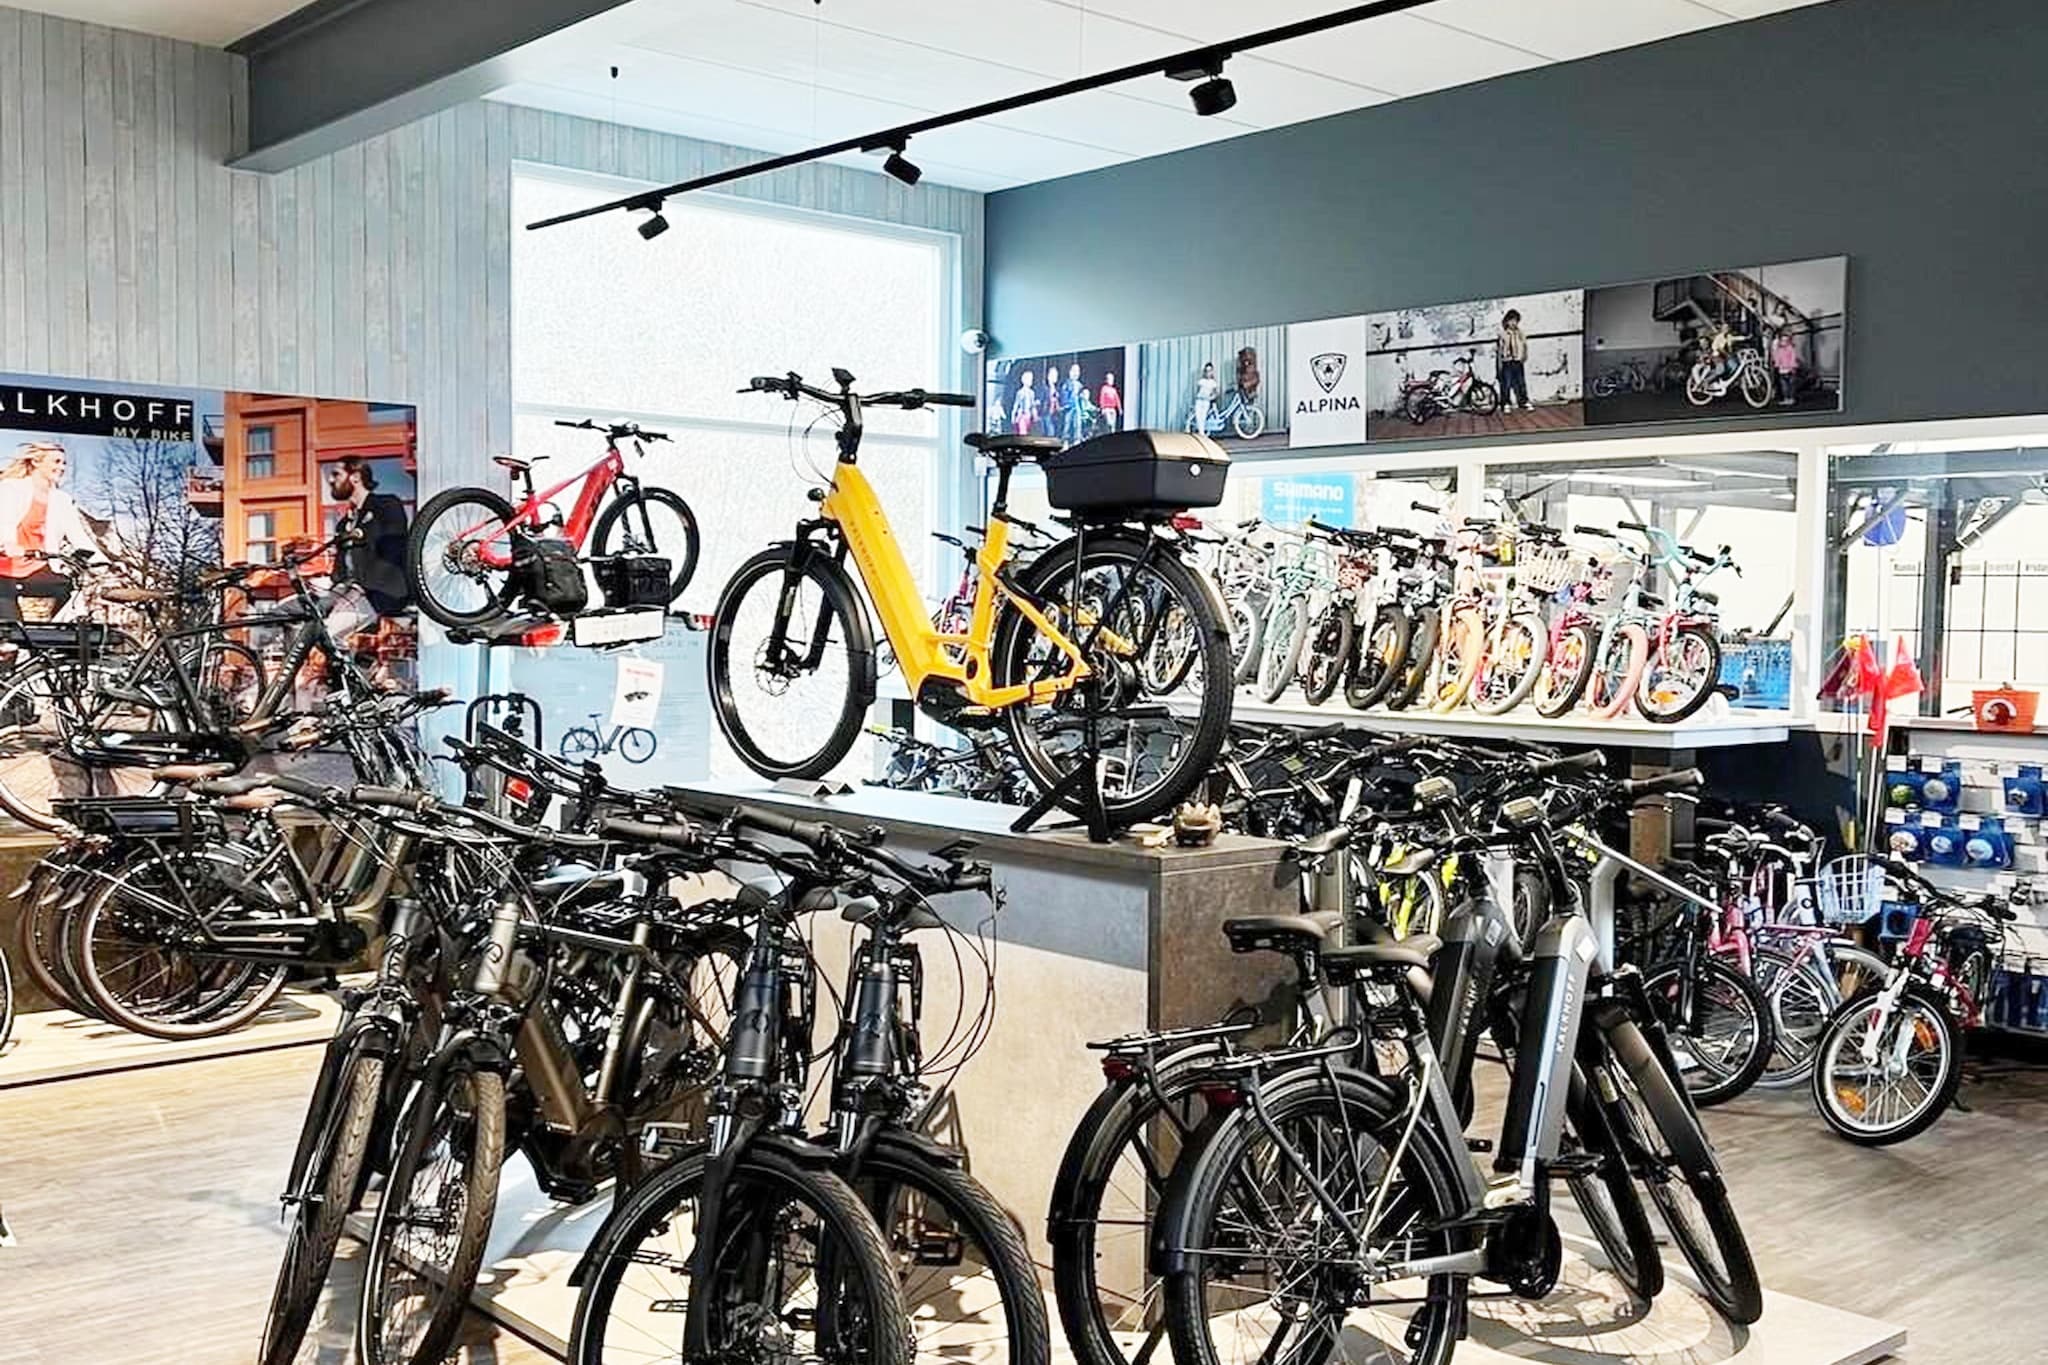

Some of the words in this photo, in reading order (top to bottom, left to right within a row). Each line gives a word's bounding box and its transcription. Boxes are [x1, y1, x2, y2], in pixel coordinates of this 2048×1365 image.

[0, 392, 192, 424] LKHOFF
[1296, 396, 1360, 414] ALPINA
[113, 427, 140, 440] MY
[151, 430, 192, 442] BIKE
